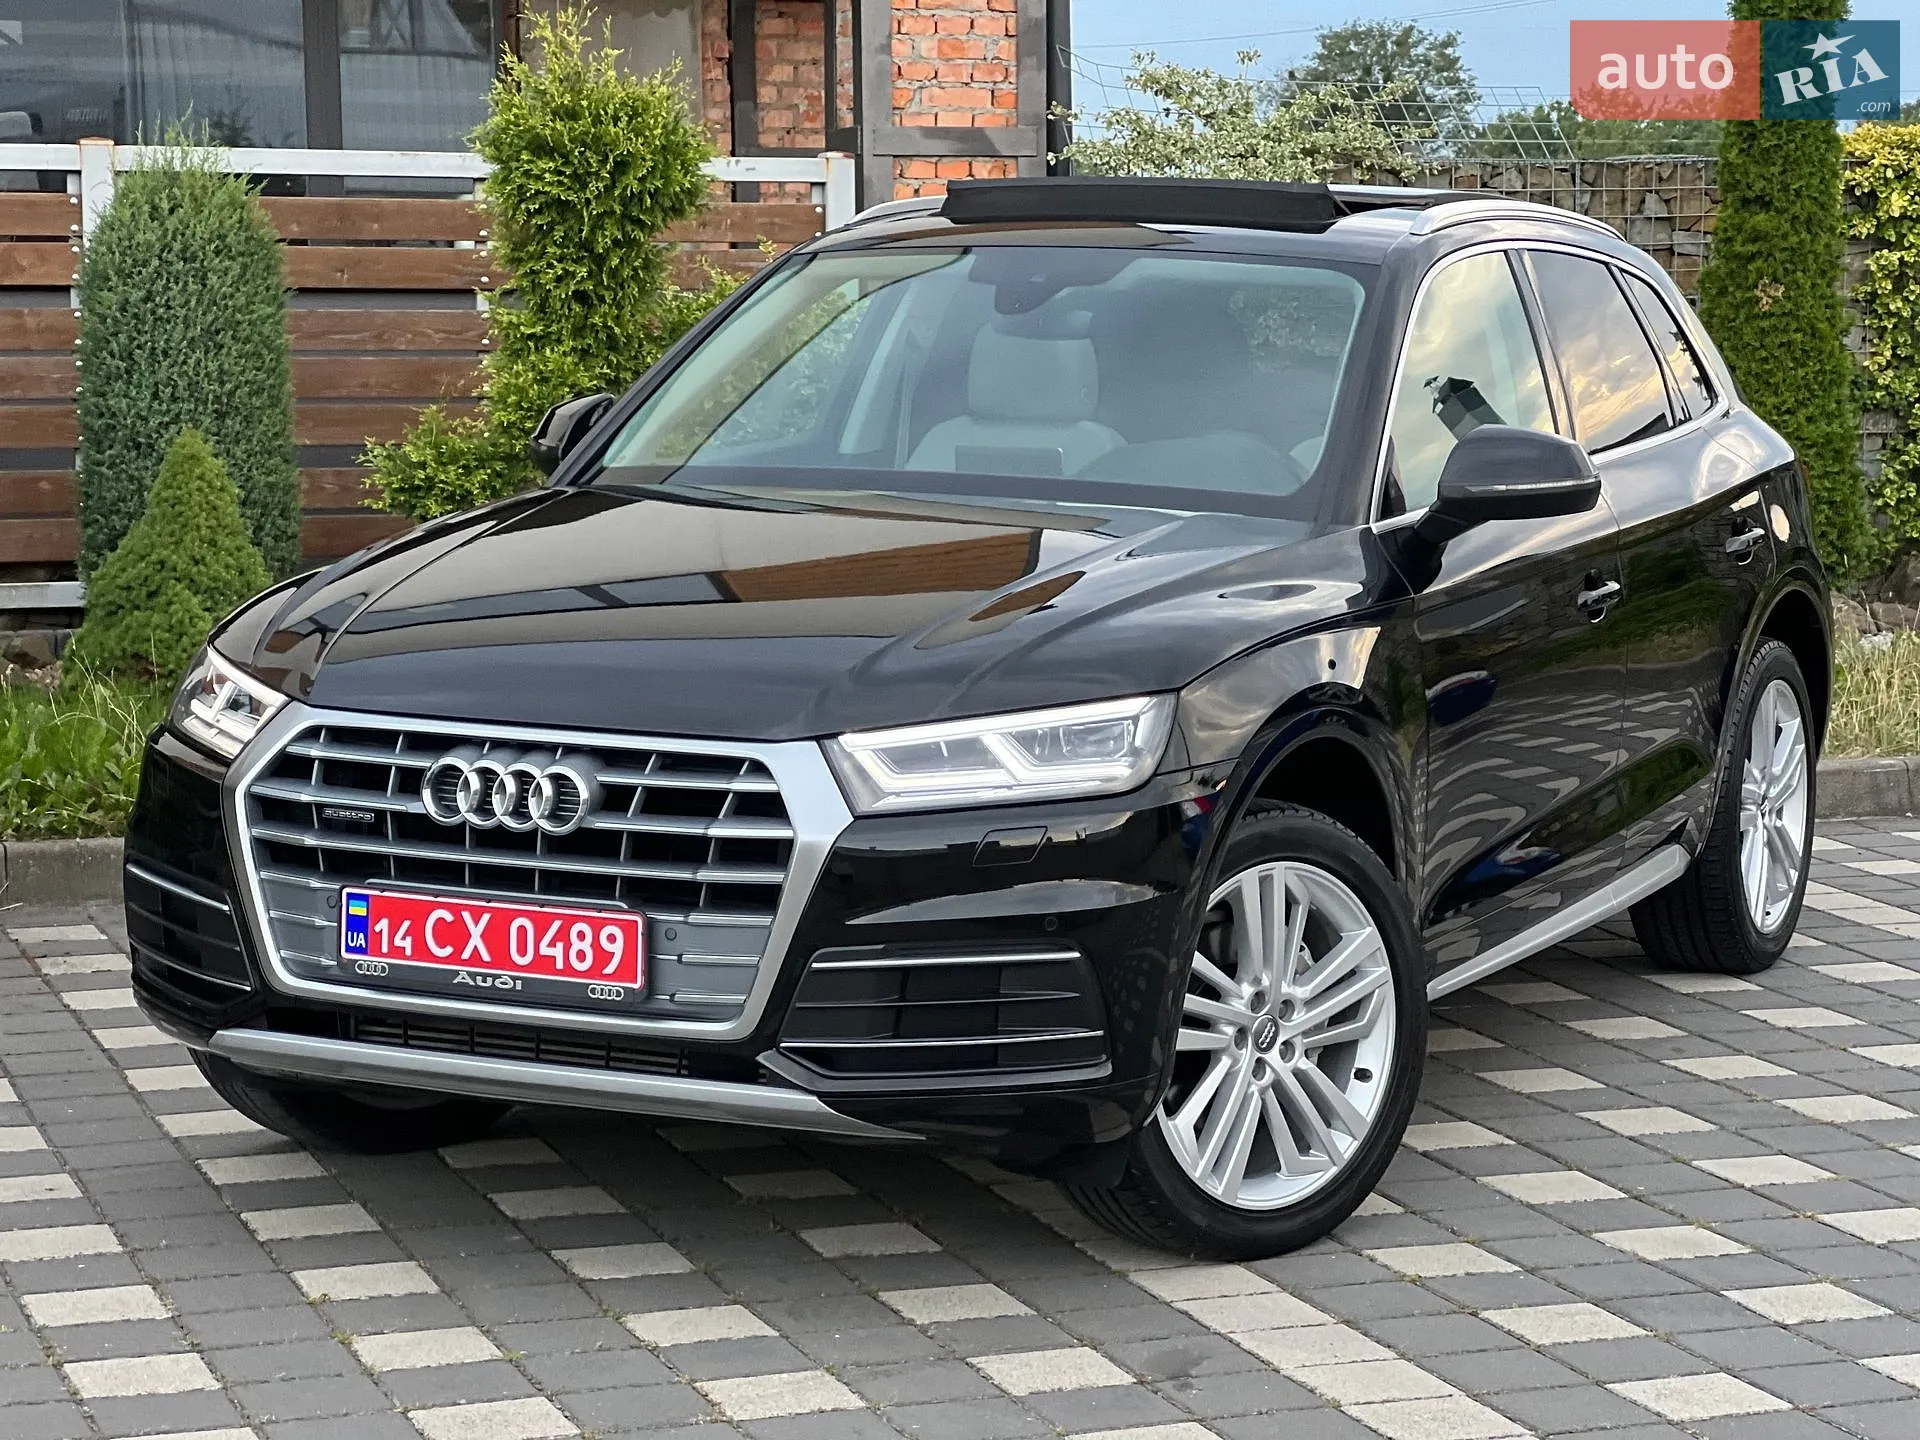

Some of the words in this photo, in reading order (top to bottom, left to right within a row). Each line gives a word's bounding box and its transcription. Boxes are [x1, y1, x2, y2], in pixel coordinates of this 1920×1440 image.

[324, 809, 372, 820] quattro
[348, 931, 366, 948] UA
[373, 917, 412, 956] 14
[424, 908, 492, 962] CX
[509, 917, 624, 975] 0489
[452, 971, 523, 990] Audi
